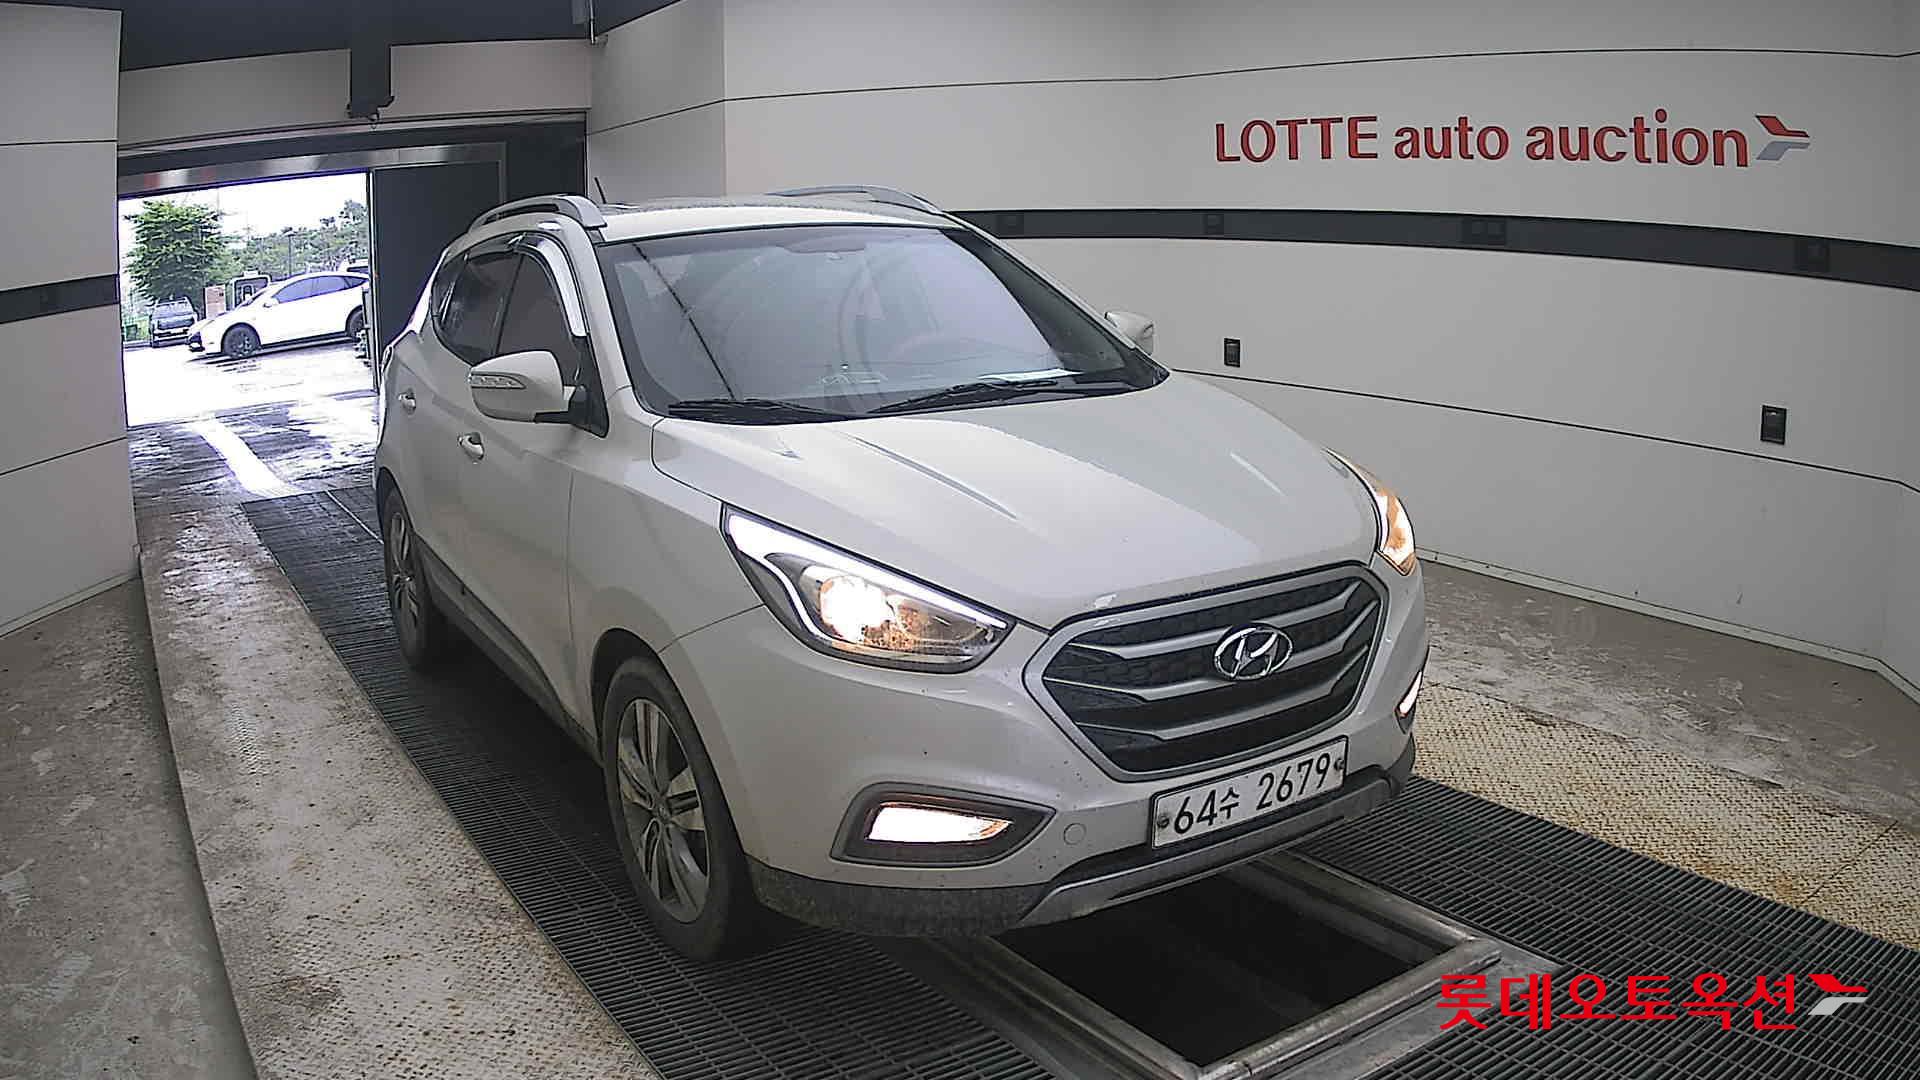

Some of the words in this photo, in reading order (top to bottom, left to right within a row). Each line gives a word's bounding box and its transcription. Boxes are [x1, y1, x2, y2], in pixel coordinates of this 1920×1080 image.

[1215, 115, 1378, 163] LOTTE
[1394, 116, 1509, 161] auto
[1525, 108, 1749, 168] auction
[1174, 787, 1240, 835] 64수
[1256, 752, 1331, 811] 2679
